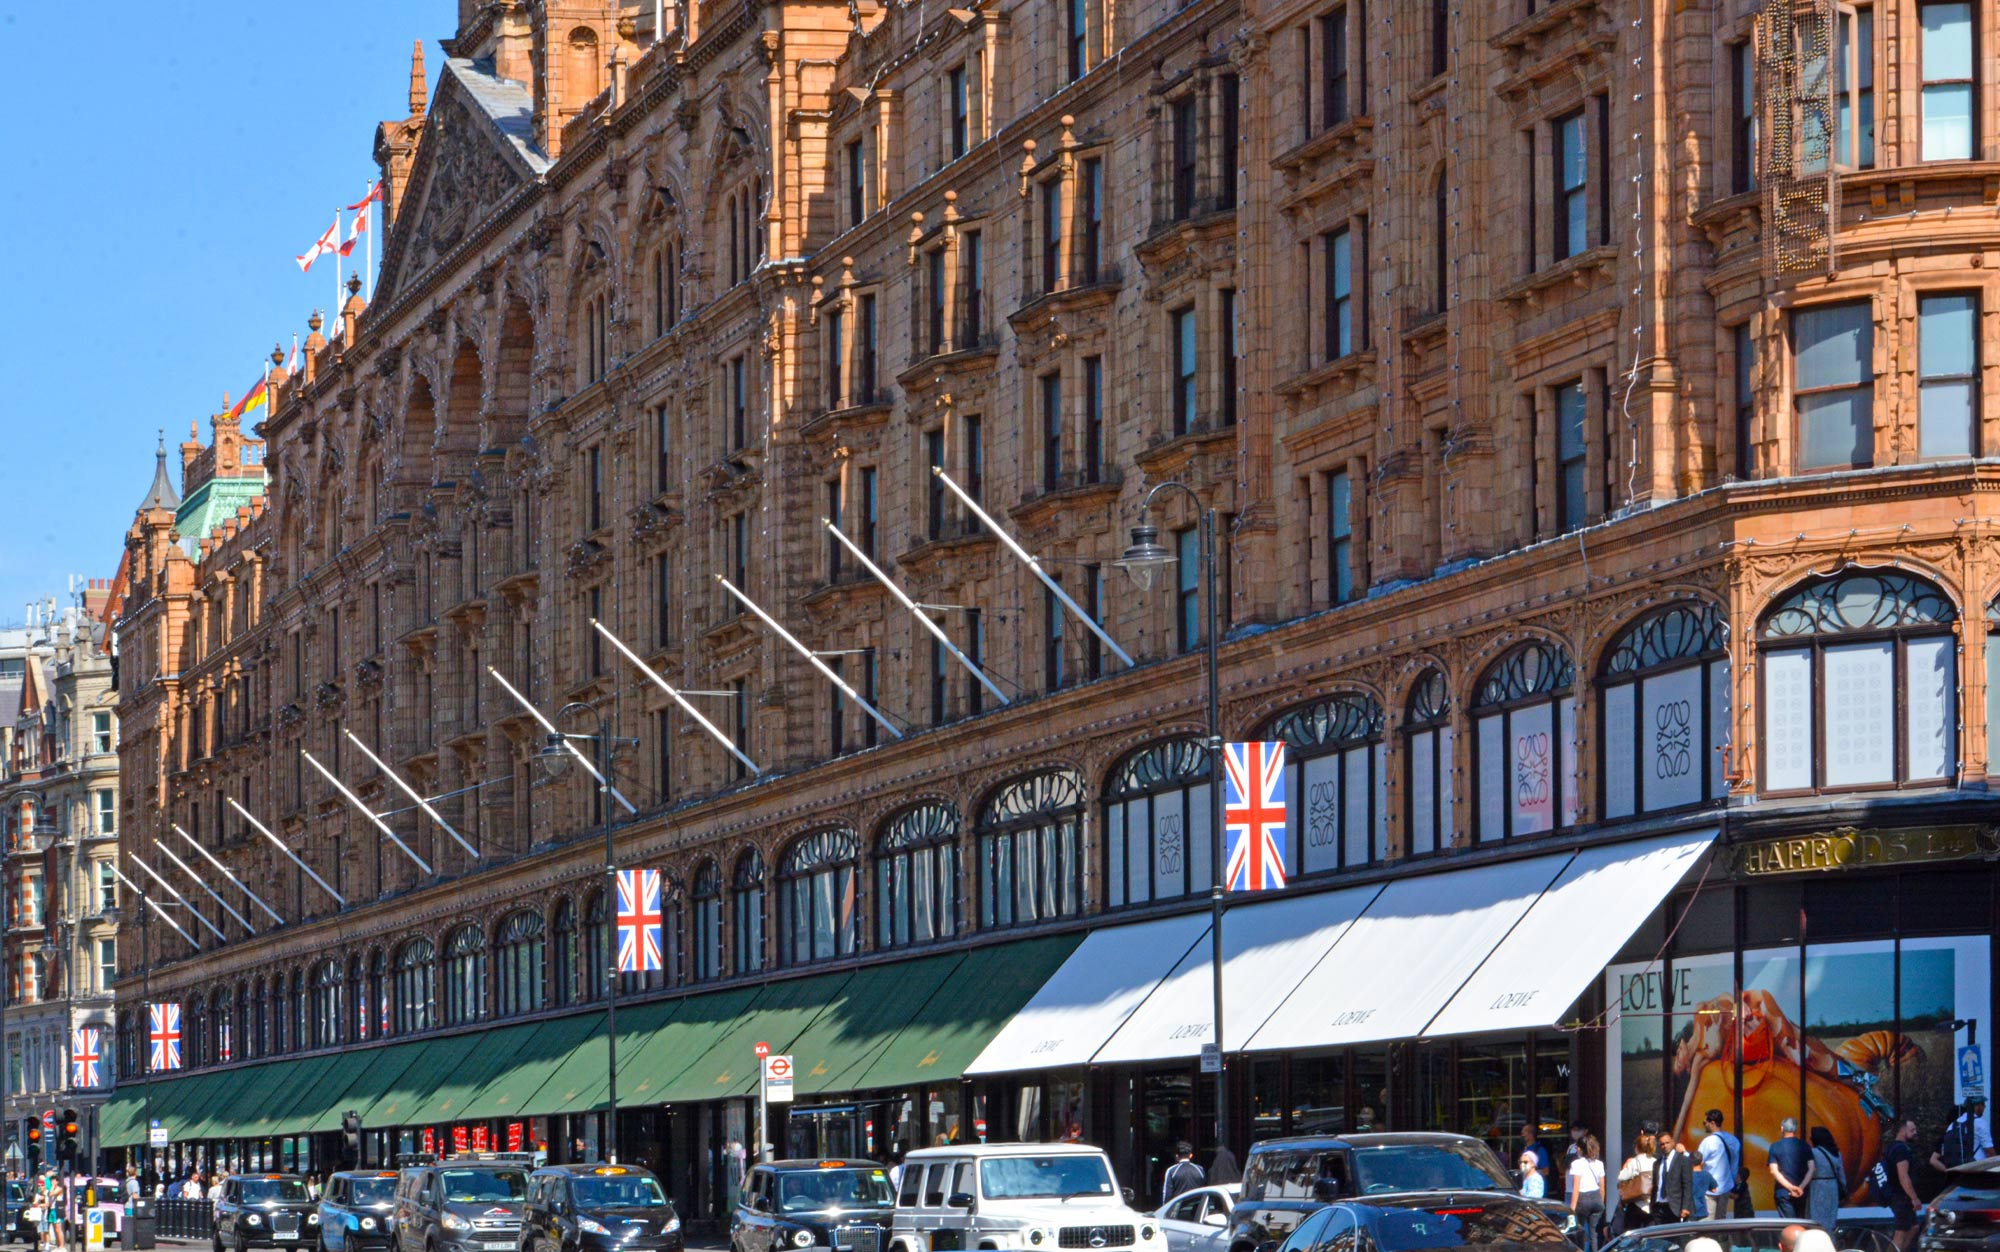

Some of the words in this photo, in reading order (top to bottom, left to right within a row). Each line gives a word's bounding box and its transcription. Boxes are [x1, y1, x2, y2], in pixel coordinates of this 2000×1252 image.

[1745, 832, 1909, 872] HARRODS
[1488, 989, 1540, 1010] LOEWE
[1620, 968, 1691, 1011] LOEWE
[1331, 1008, 1377, 1026] LOEWE
